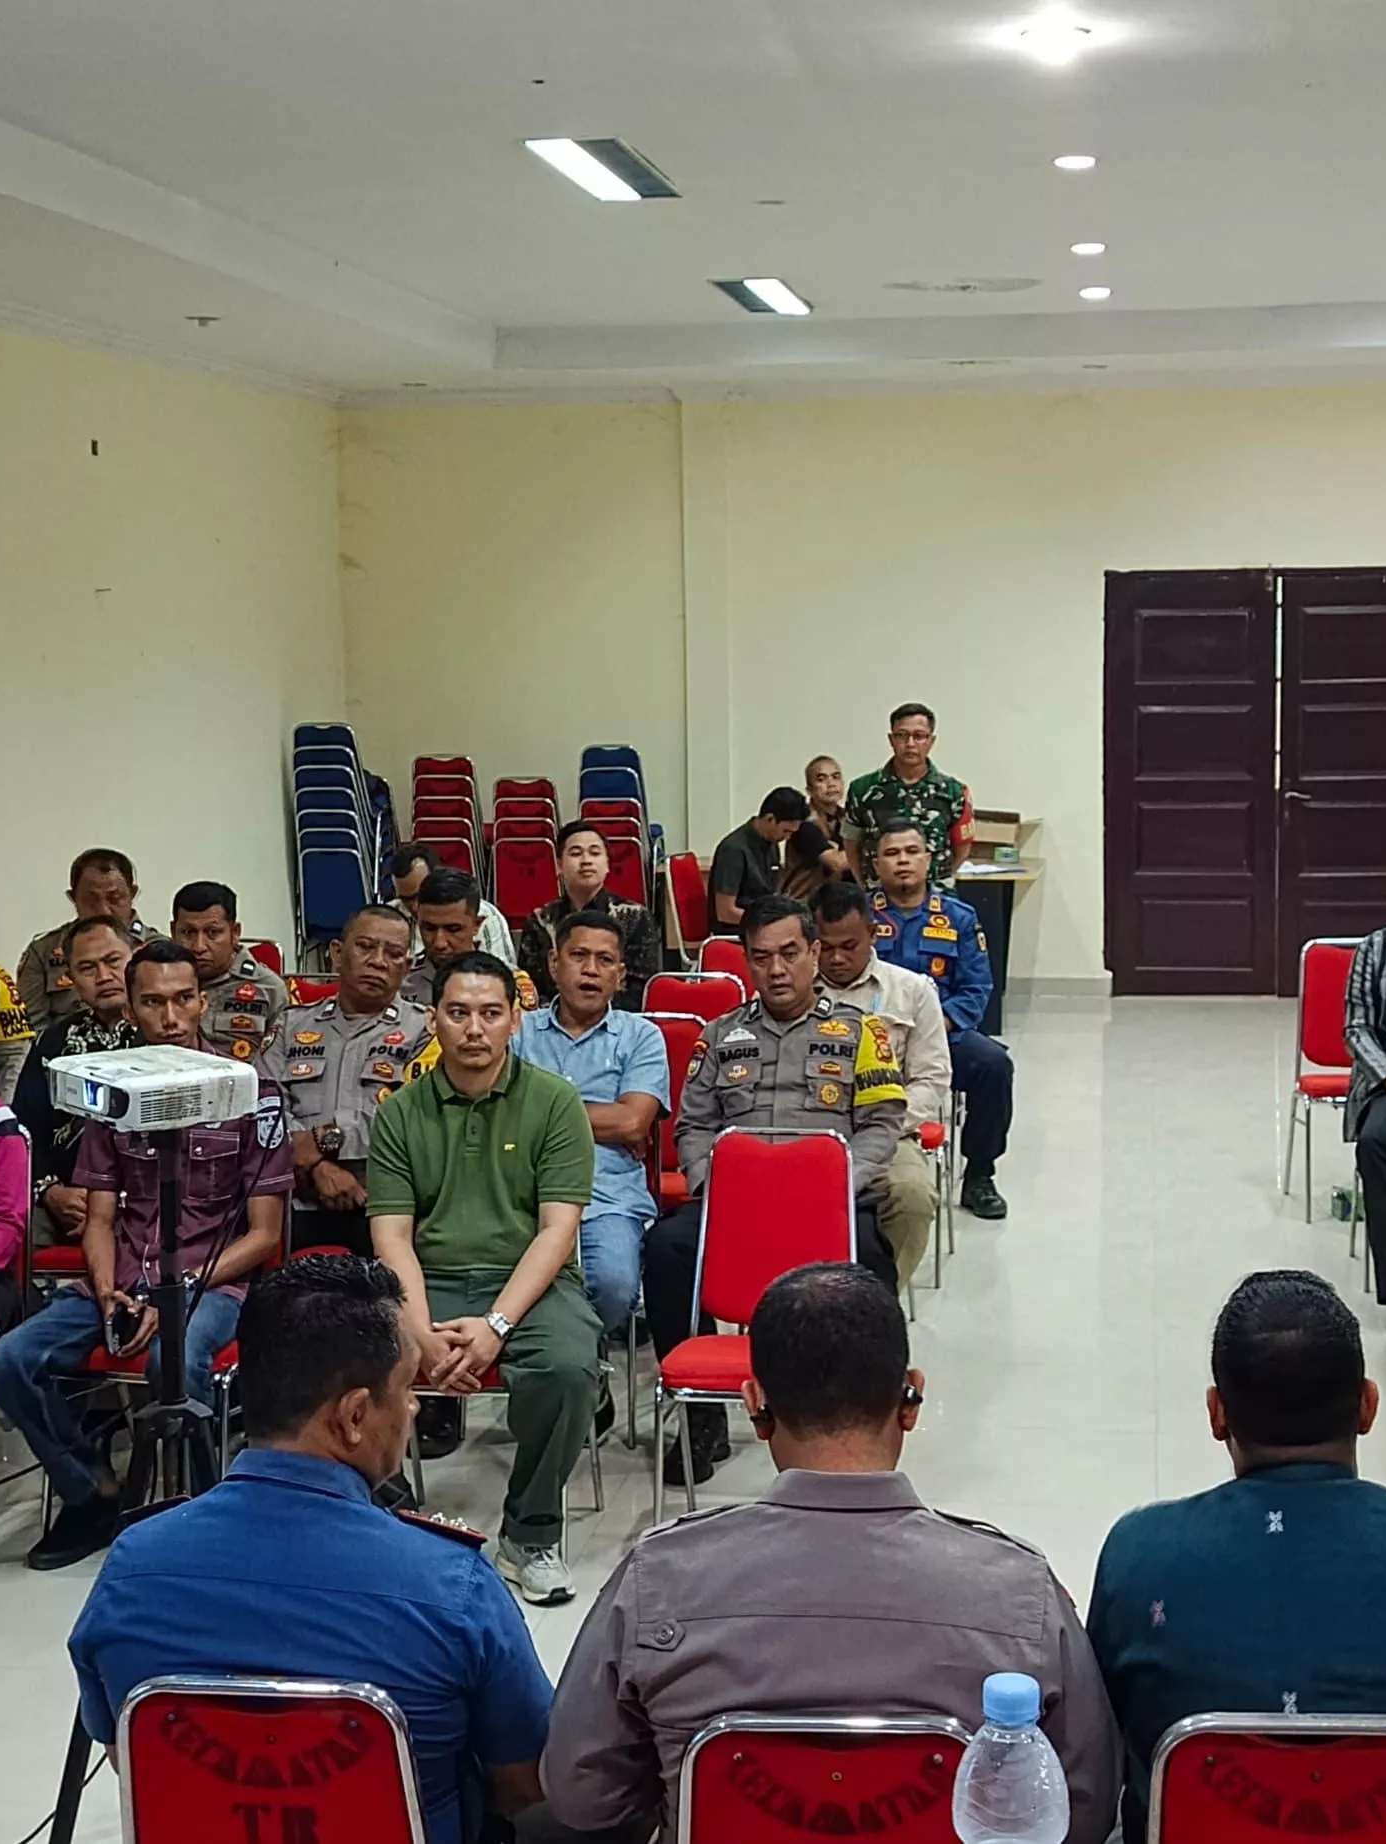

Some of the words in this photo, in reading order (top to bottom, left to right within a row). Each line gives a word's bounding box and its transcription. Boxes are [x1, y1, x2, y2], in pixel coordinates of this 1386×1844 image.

[368, 1045, 410, 1060] POLRI
[718, 1046, 760, 1064] BAGUS
[809, 1043, 853, 1059] POLRI
